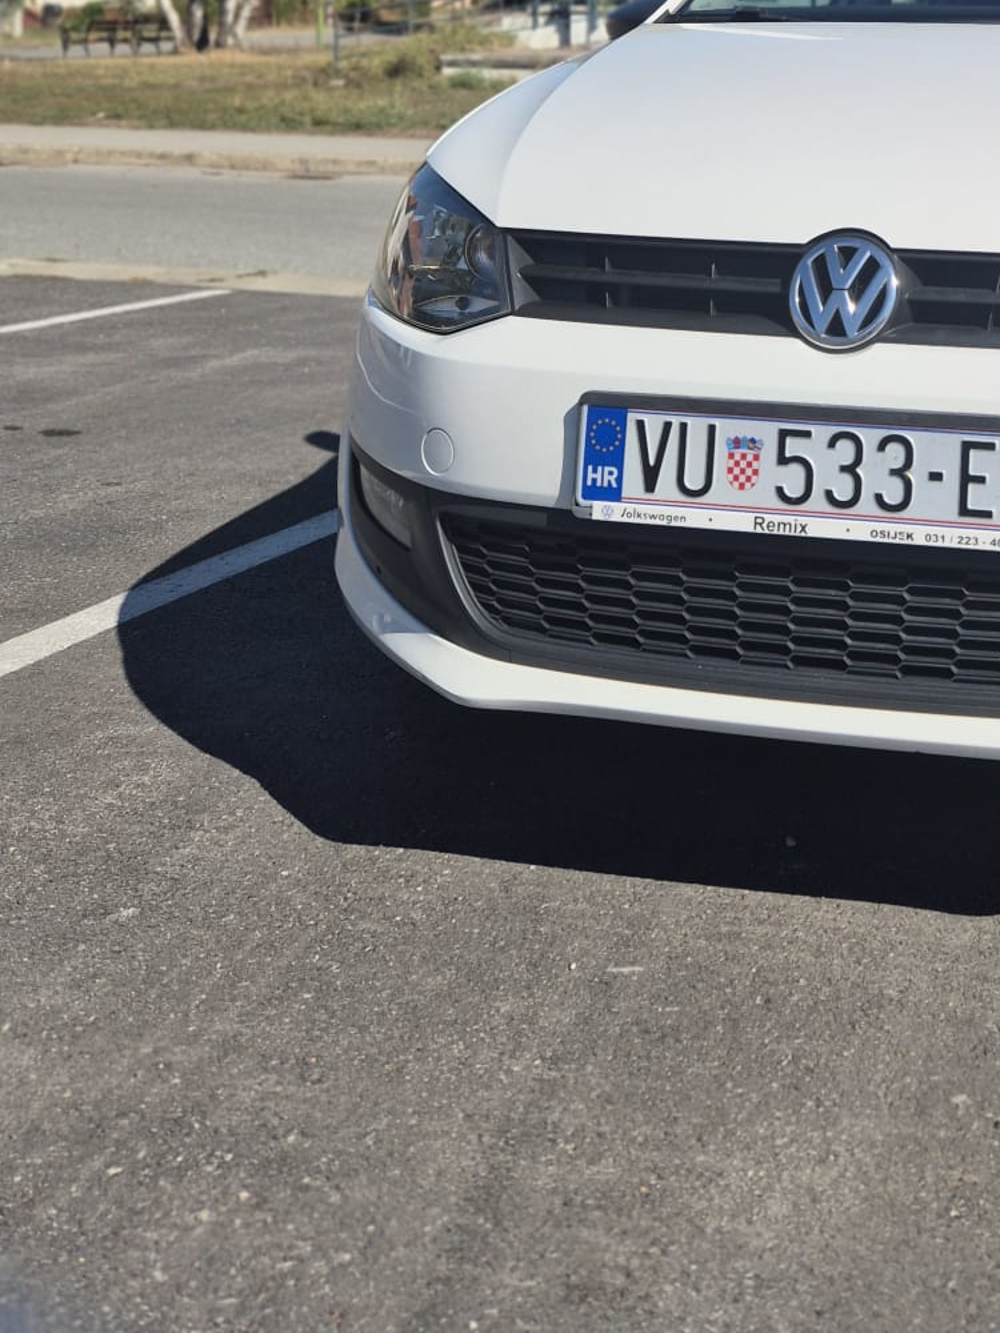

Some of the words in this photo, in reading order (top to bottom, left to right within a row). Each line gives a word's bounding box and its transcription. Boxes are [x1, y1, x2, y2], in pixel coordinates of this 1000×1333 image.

[790, 236, 896, 348] VW
[636, 419, 716, 498] VU
[586, 464, 618, 488] HR
[753, 515, 808, 534] Remix
[870, 529, 915, 541] OSIJEK
[924, 533, 946, 543] 031
[957, 535, 979, 546] 223
